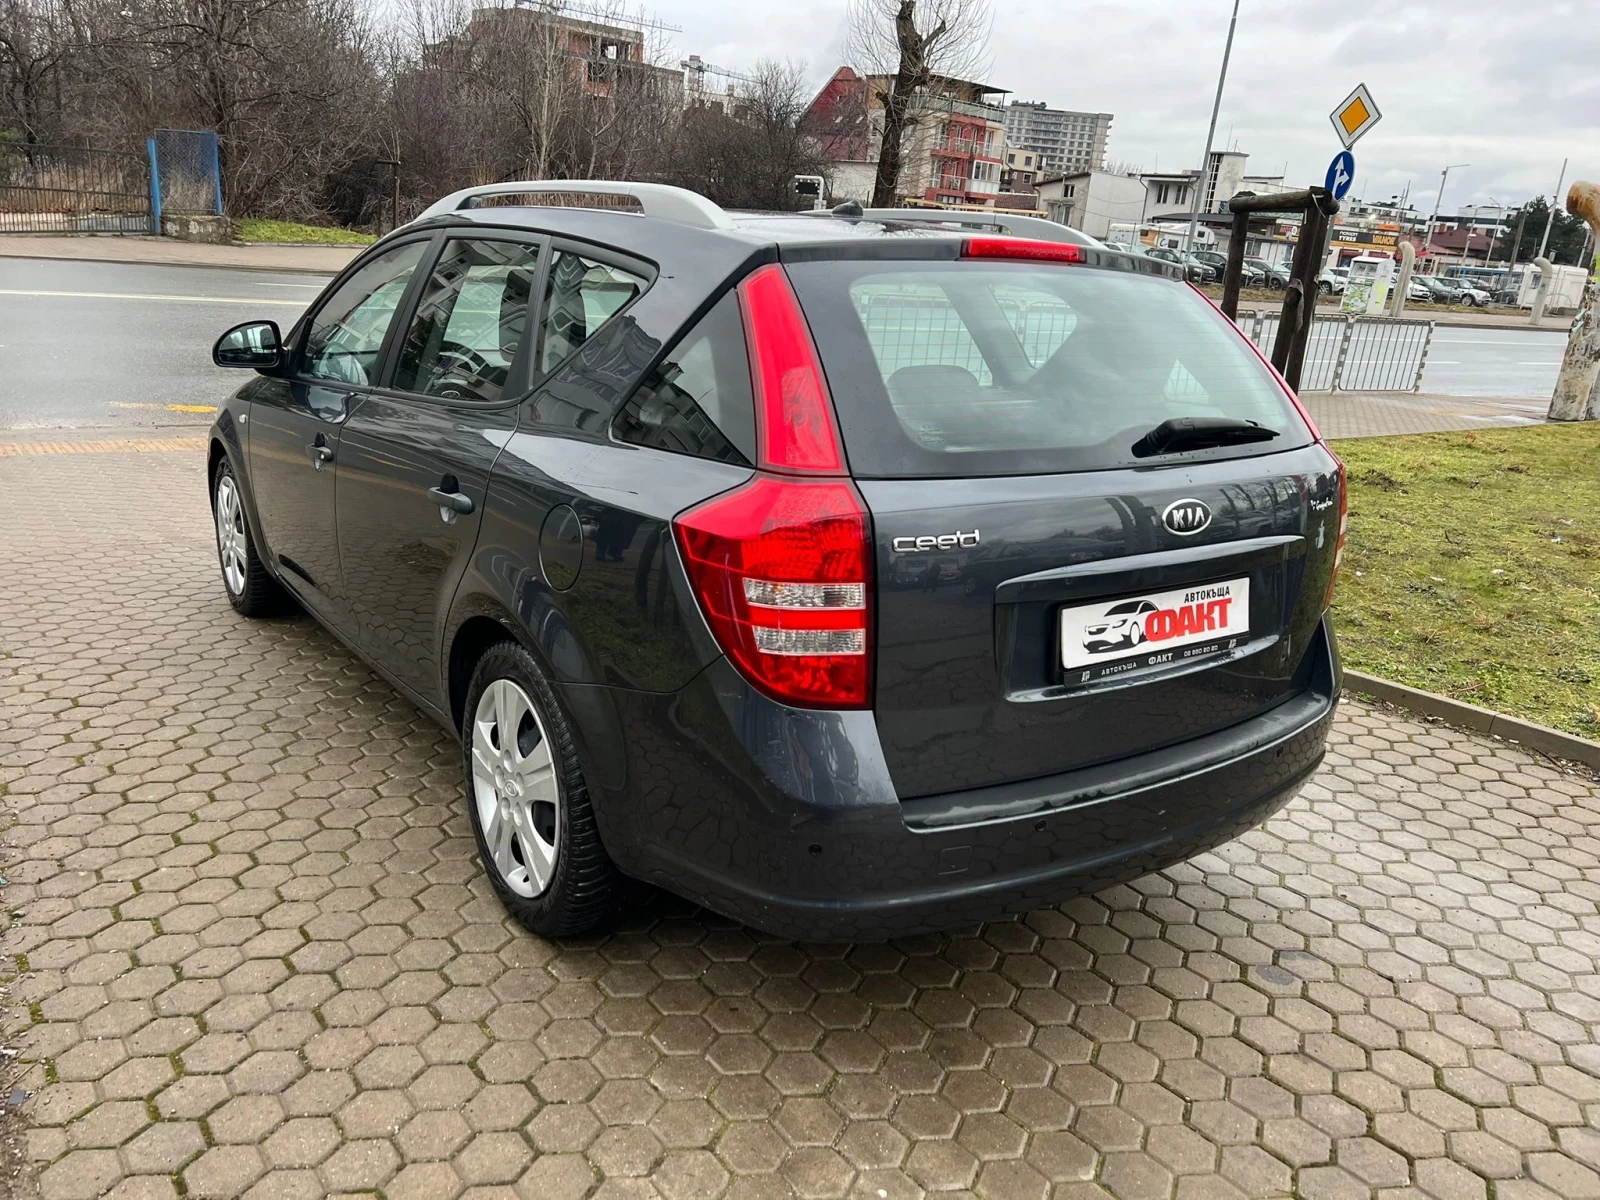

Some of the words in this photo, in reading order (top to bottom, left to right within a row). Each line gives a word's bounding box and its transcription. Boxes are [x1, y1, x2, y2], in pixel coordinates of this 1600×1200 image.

[1172, 507, 1205, 529] KIA
[1184, 585, 1231, 604] АВТОКЪЩА
[1144, 597, 1232, 642] ФАКТ
[1148, 652, 1174, 665] ФАКТ
